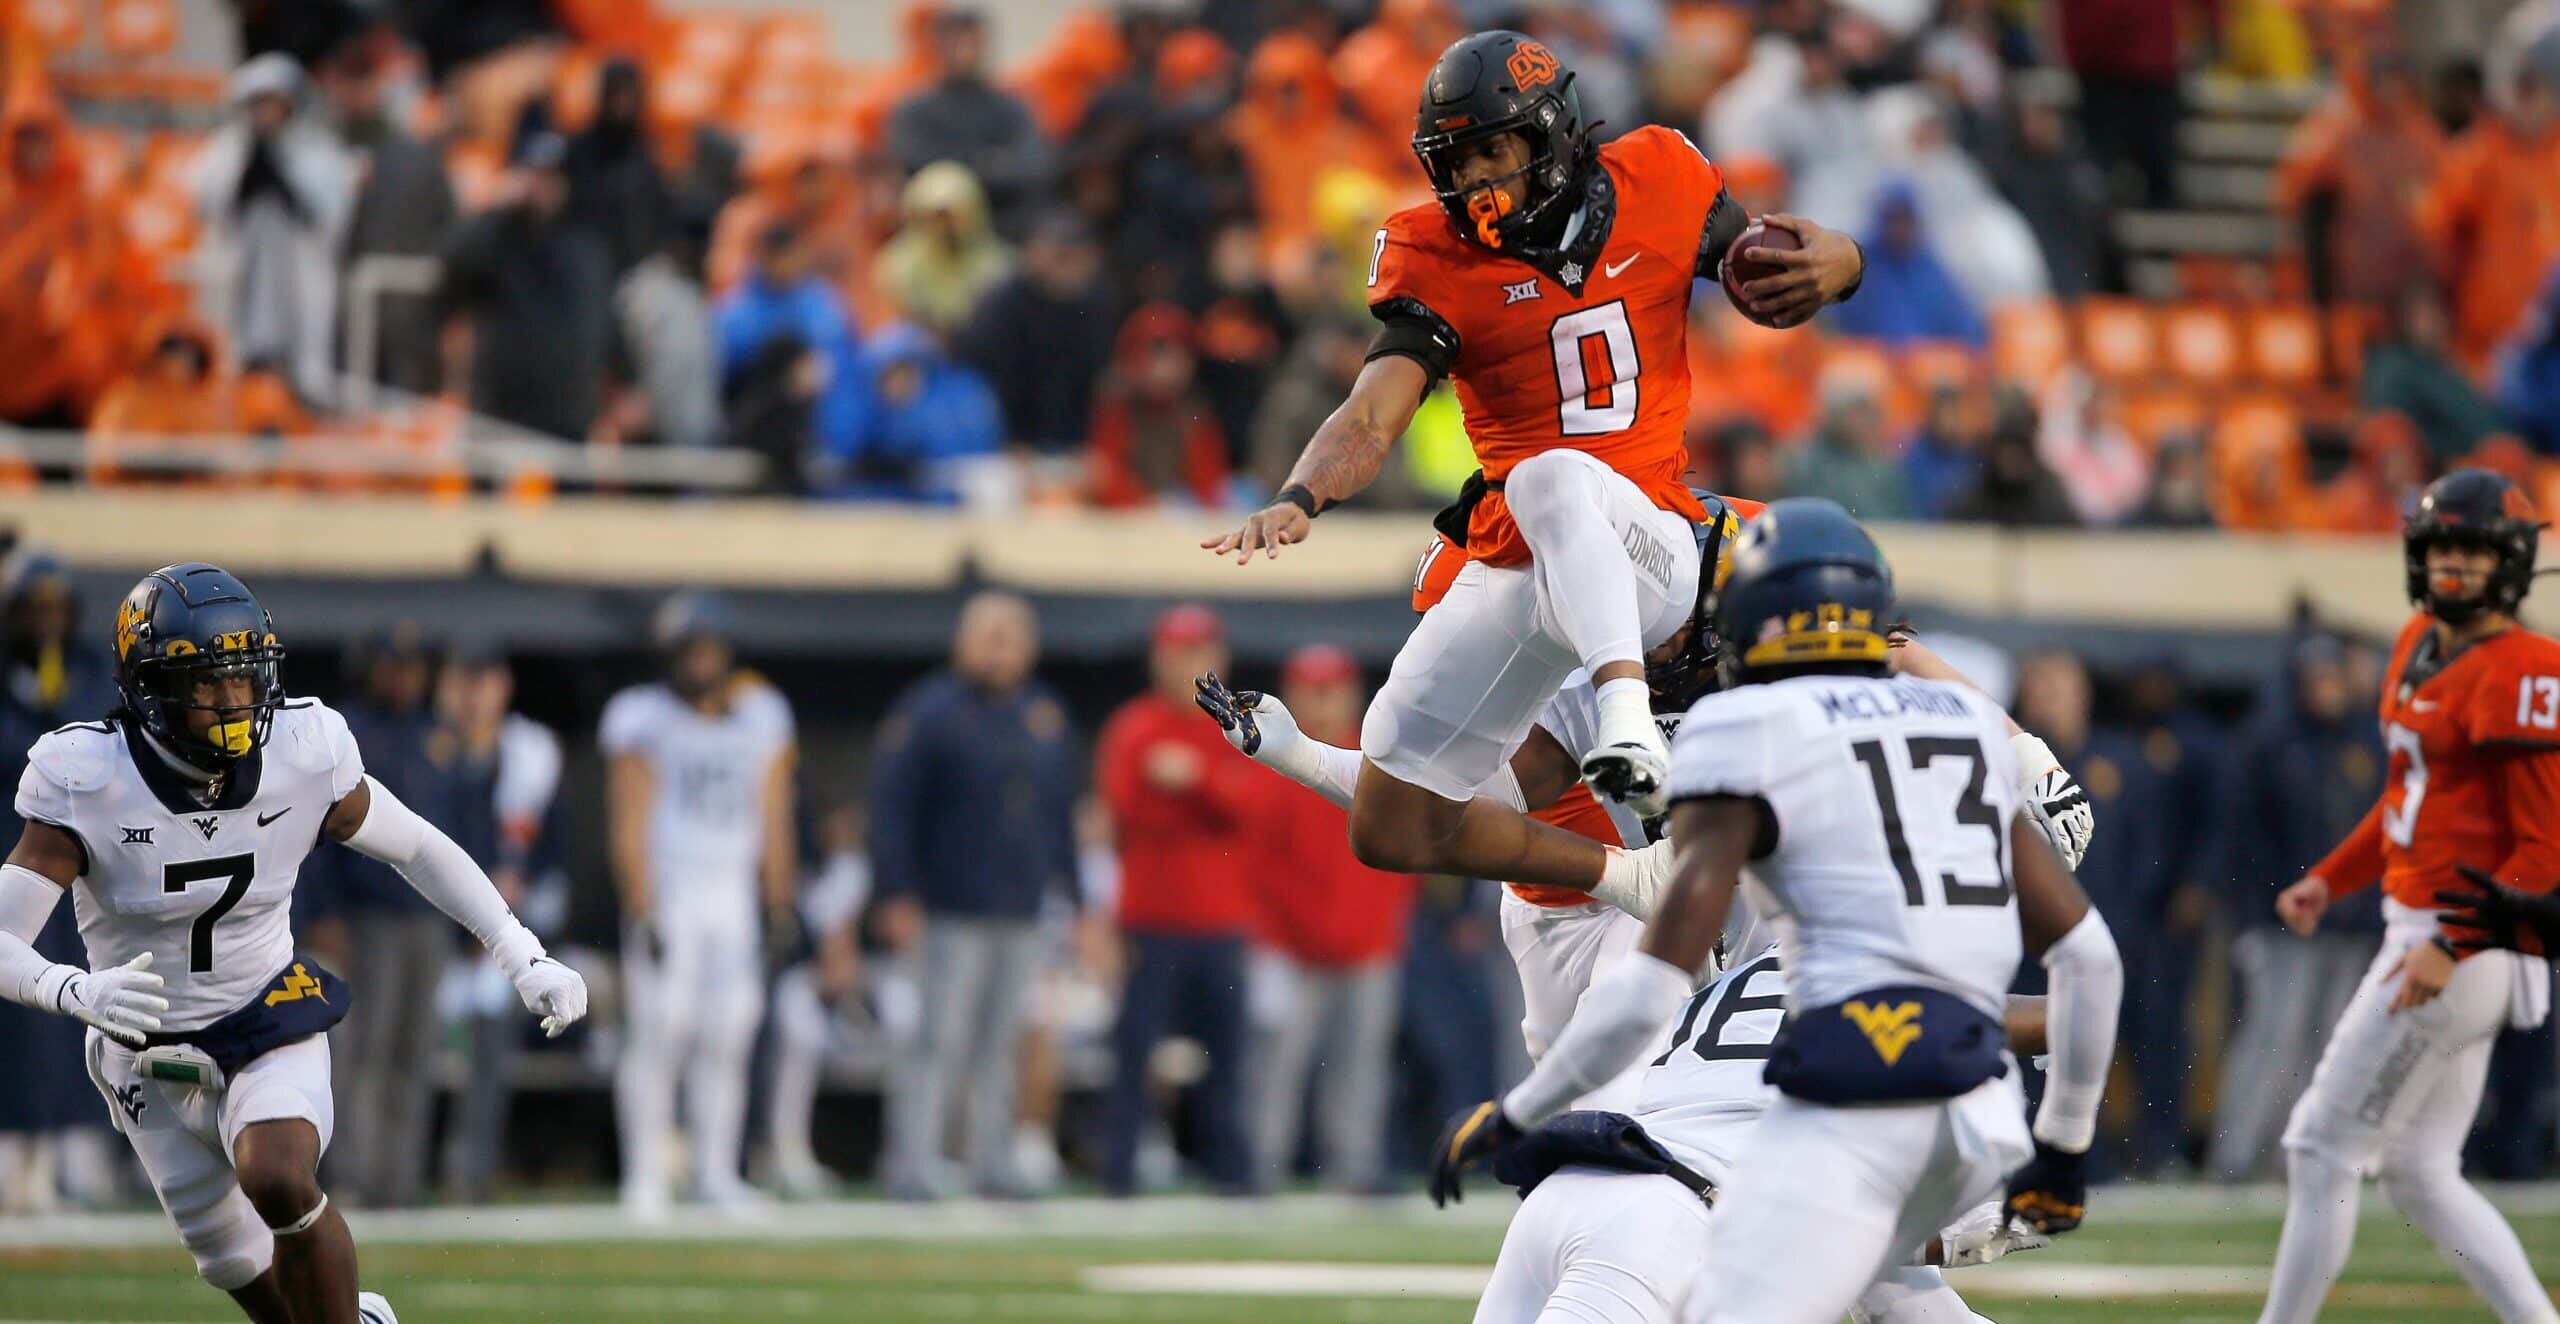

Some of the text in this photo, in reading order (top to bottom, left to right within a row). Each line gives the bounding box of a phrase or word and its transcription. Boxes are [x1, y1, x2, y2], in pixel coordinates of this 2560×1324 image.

[1502, 278, 1541, 305] XII
[1547, 298, 1642, 436] 0
[2516, 675, 2560, 730] 13
[121, 826, 155, 845] XII
[1851, 736, 2011, 907] 13
[2380, 720, 2428, 847] 3
[162, 850, 256, 975] 7
[1650, 955, 1788, 1067] 16
